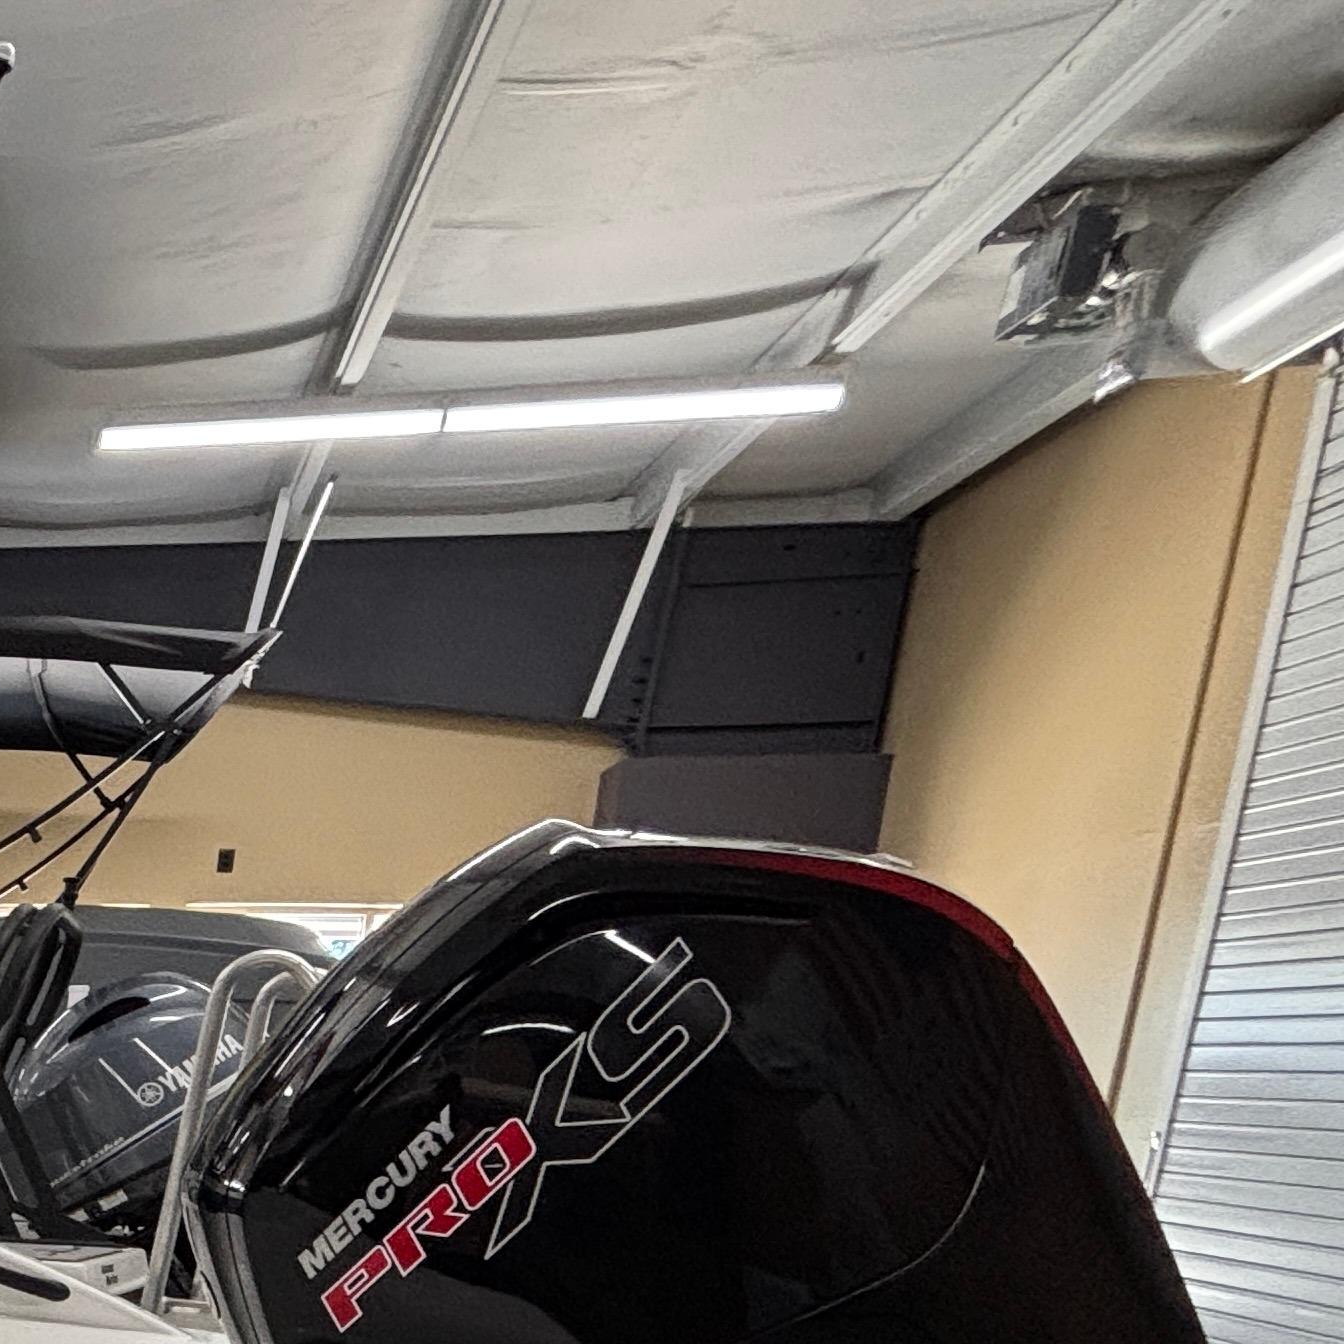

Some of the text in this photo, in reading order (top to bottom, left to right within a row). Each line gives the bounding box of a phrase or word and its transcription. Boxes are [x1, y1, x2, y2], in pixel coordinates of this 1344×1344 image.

[296, 1103, 456, 1280] MERCURY
[320, 936, 732, 1333] PRO XS
